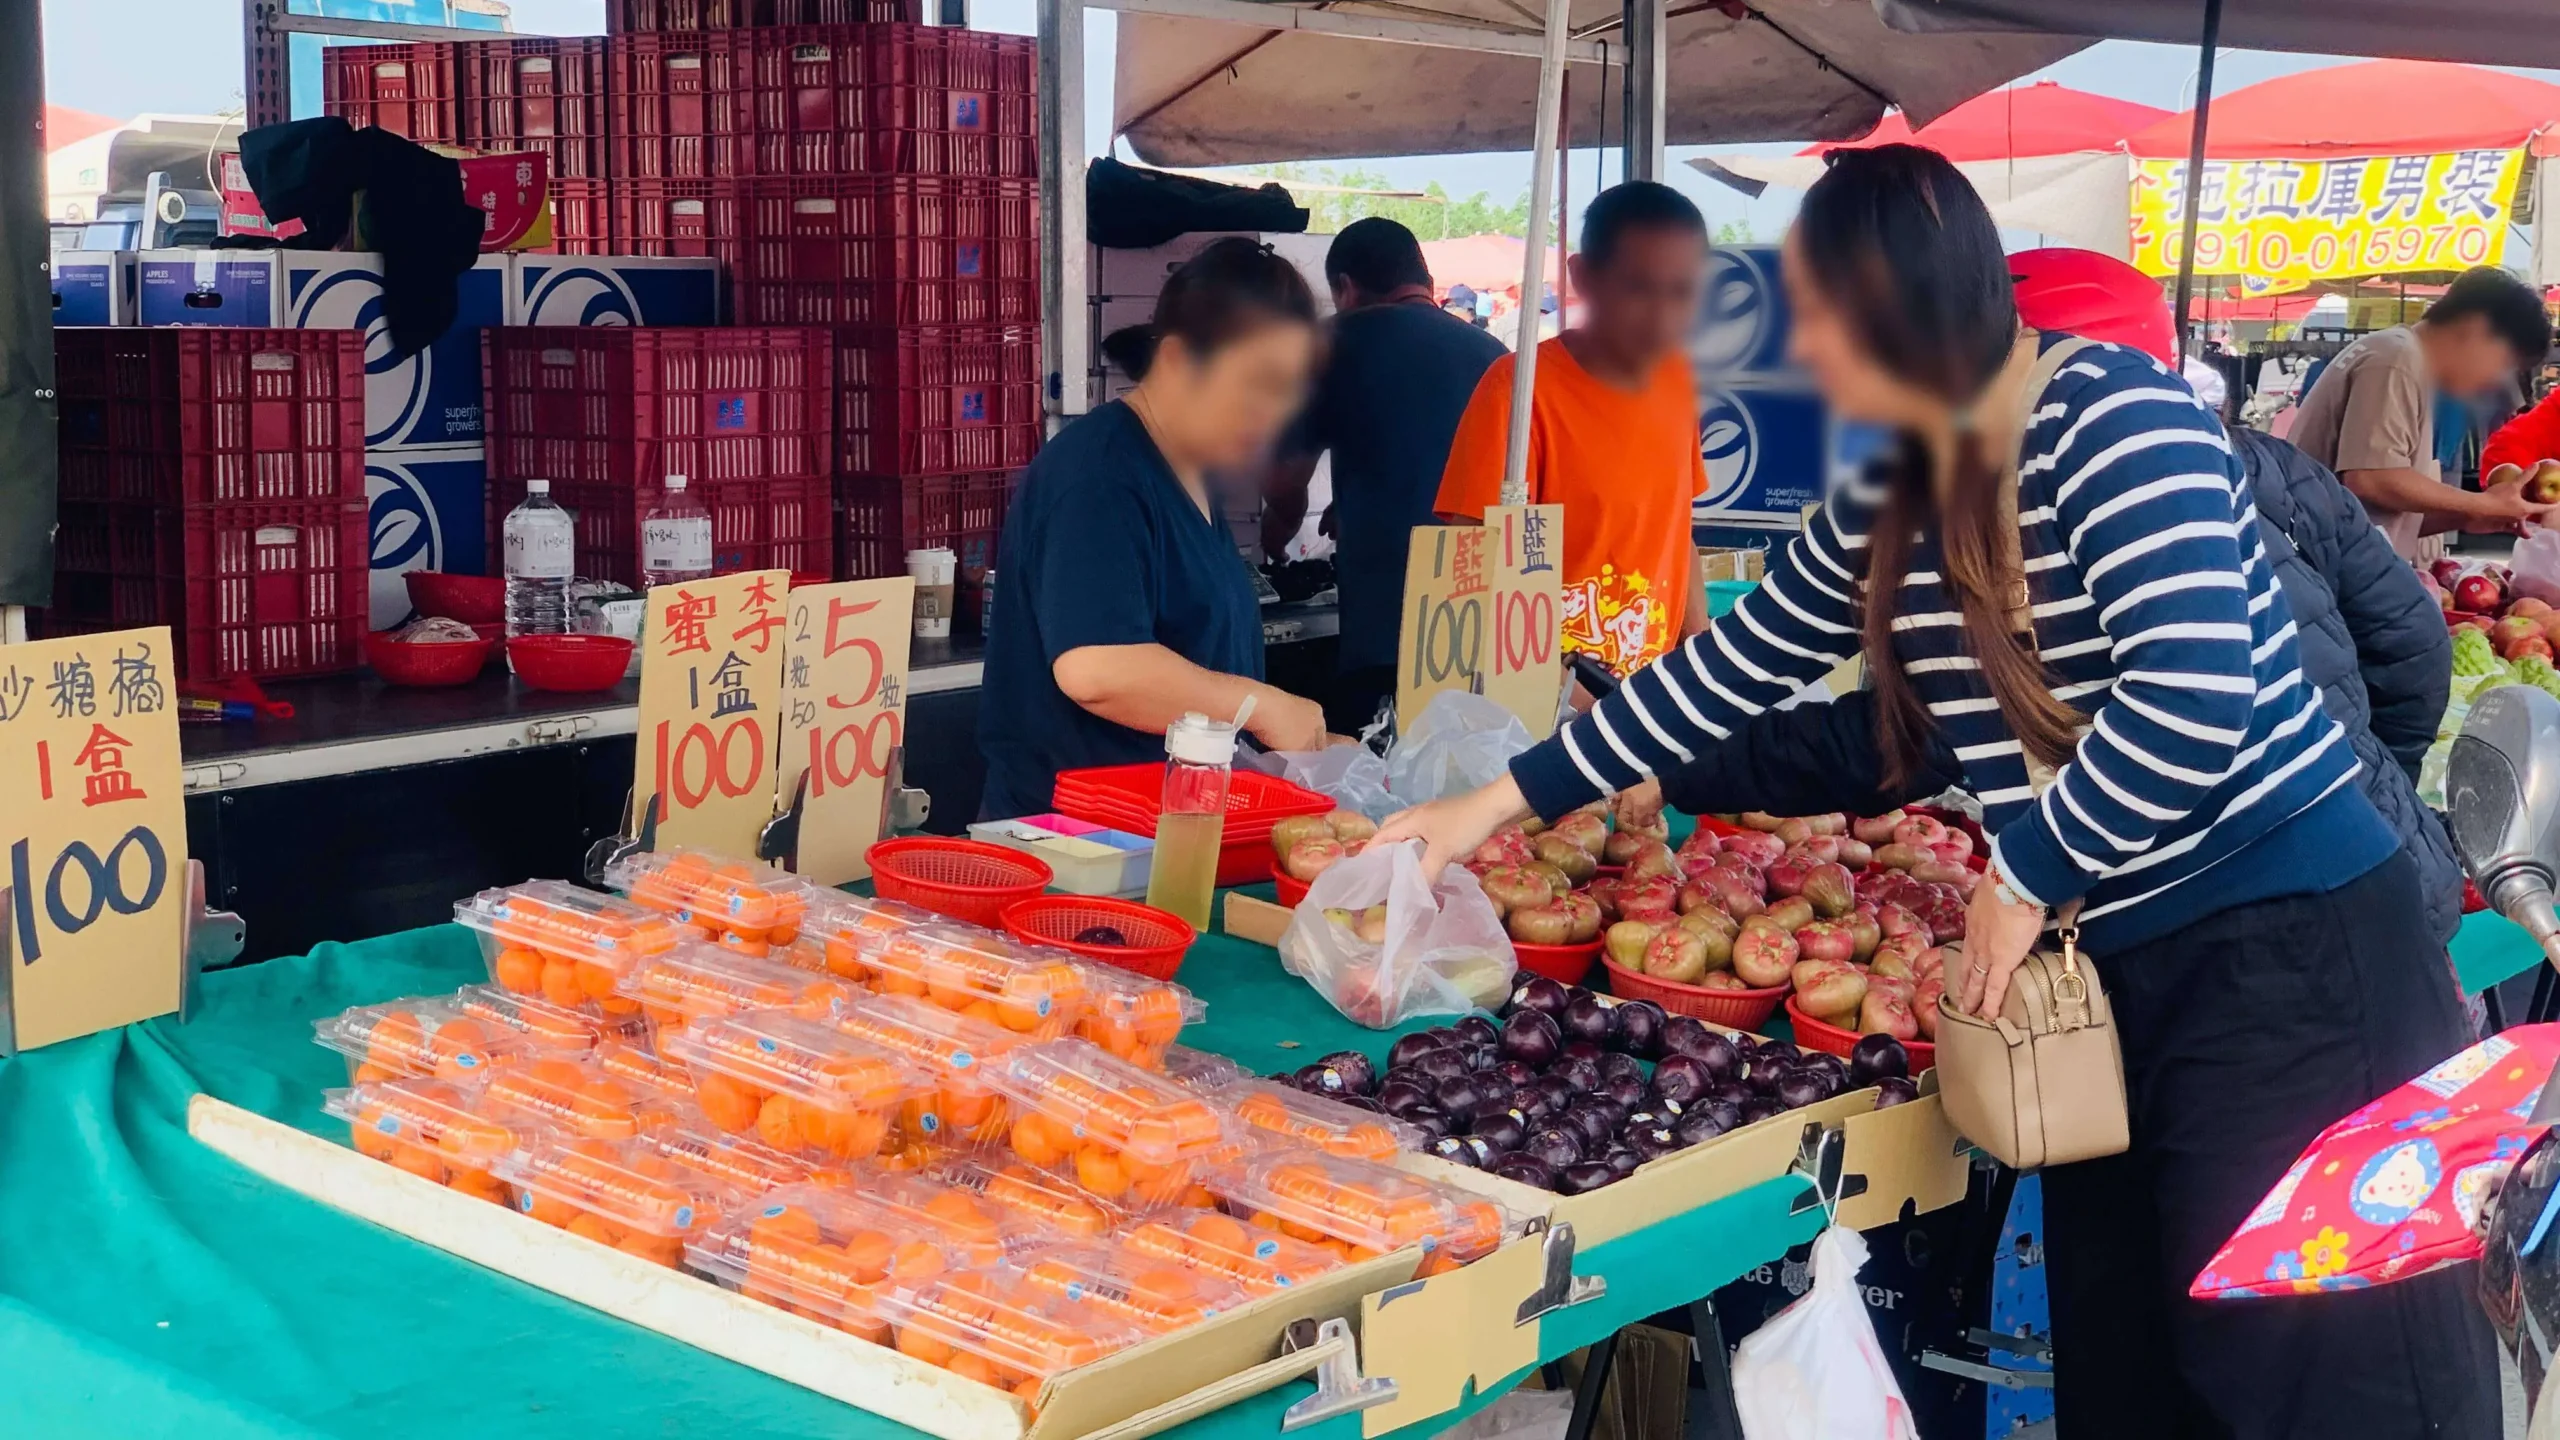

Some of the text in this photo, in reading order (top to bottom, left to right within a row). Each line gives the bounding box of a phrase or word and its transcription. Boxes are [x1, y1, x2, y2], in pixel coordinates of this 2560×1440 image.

[2168, 151, 2506, 226] 拖拉庫男裝
[146, 270, 169, 279] APPLES
[2163, 226, 2488, 271] 0910-015970
[445, 403, 481, 420] superfr
[1765, 486, 1814, 499] superfresh
[660, 575, 787, 656] 蜜李
[1414, 593, 1482, 689] 100
[1495, 590, 1554, 677] 100
[790, 697, 816, 730] 50
[656, 717, 764, 826] 100
[808, 710, 902, 799] 100
[11, 825, 168, 967] 100
